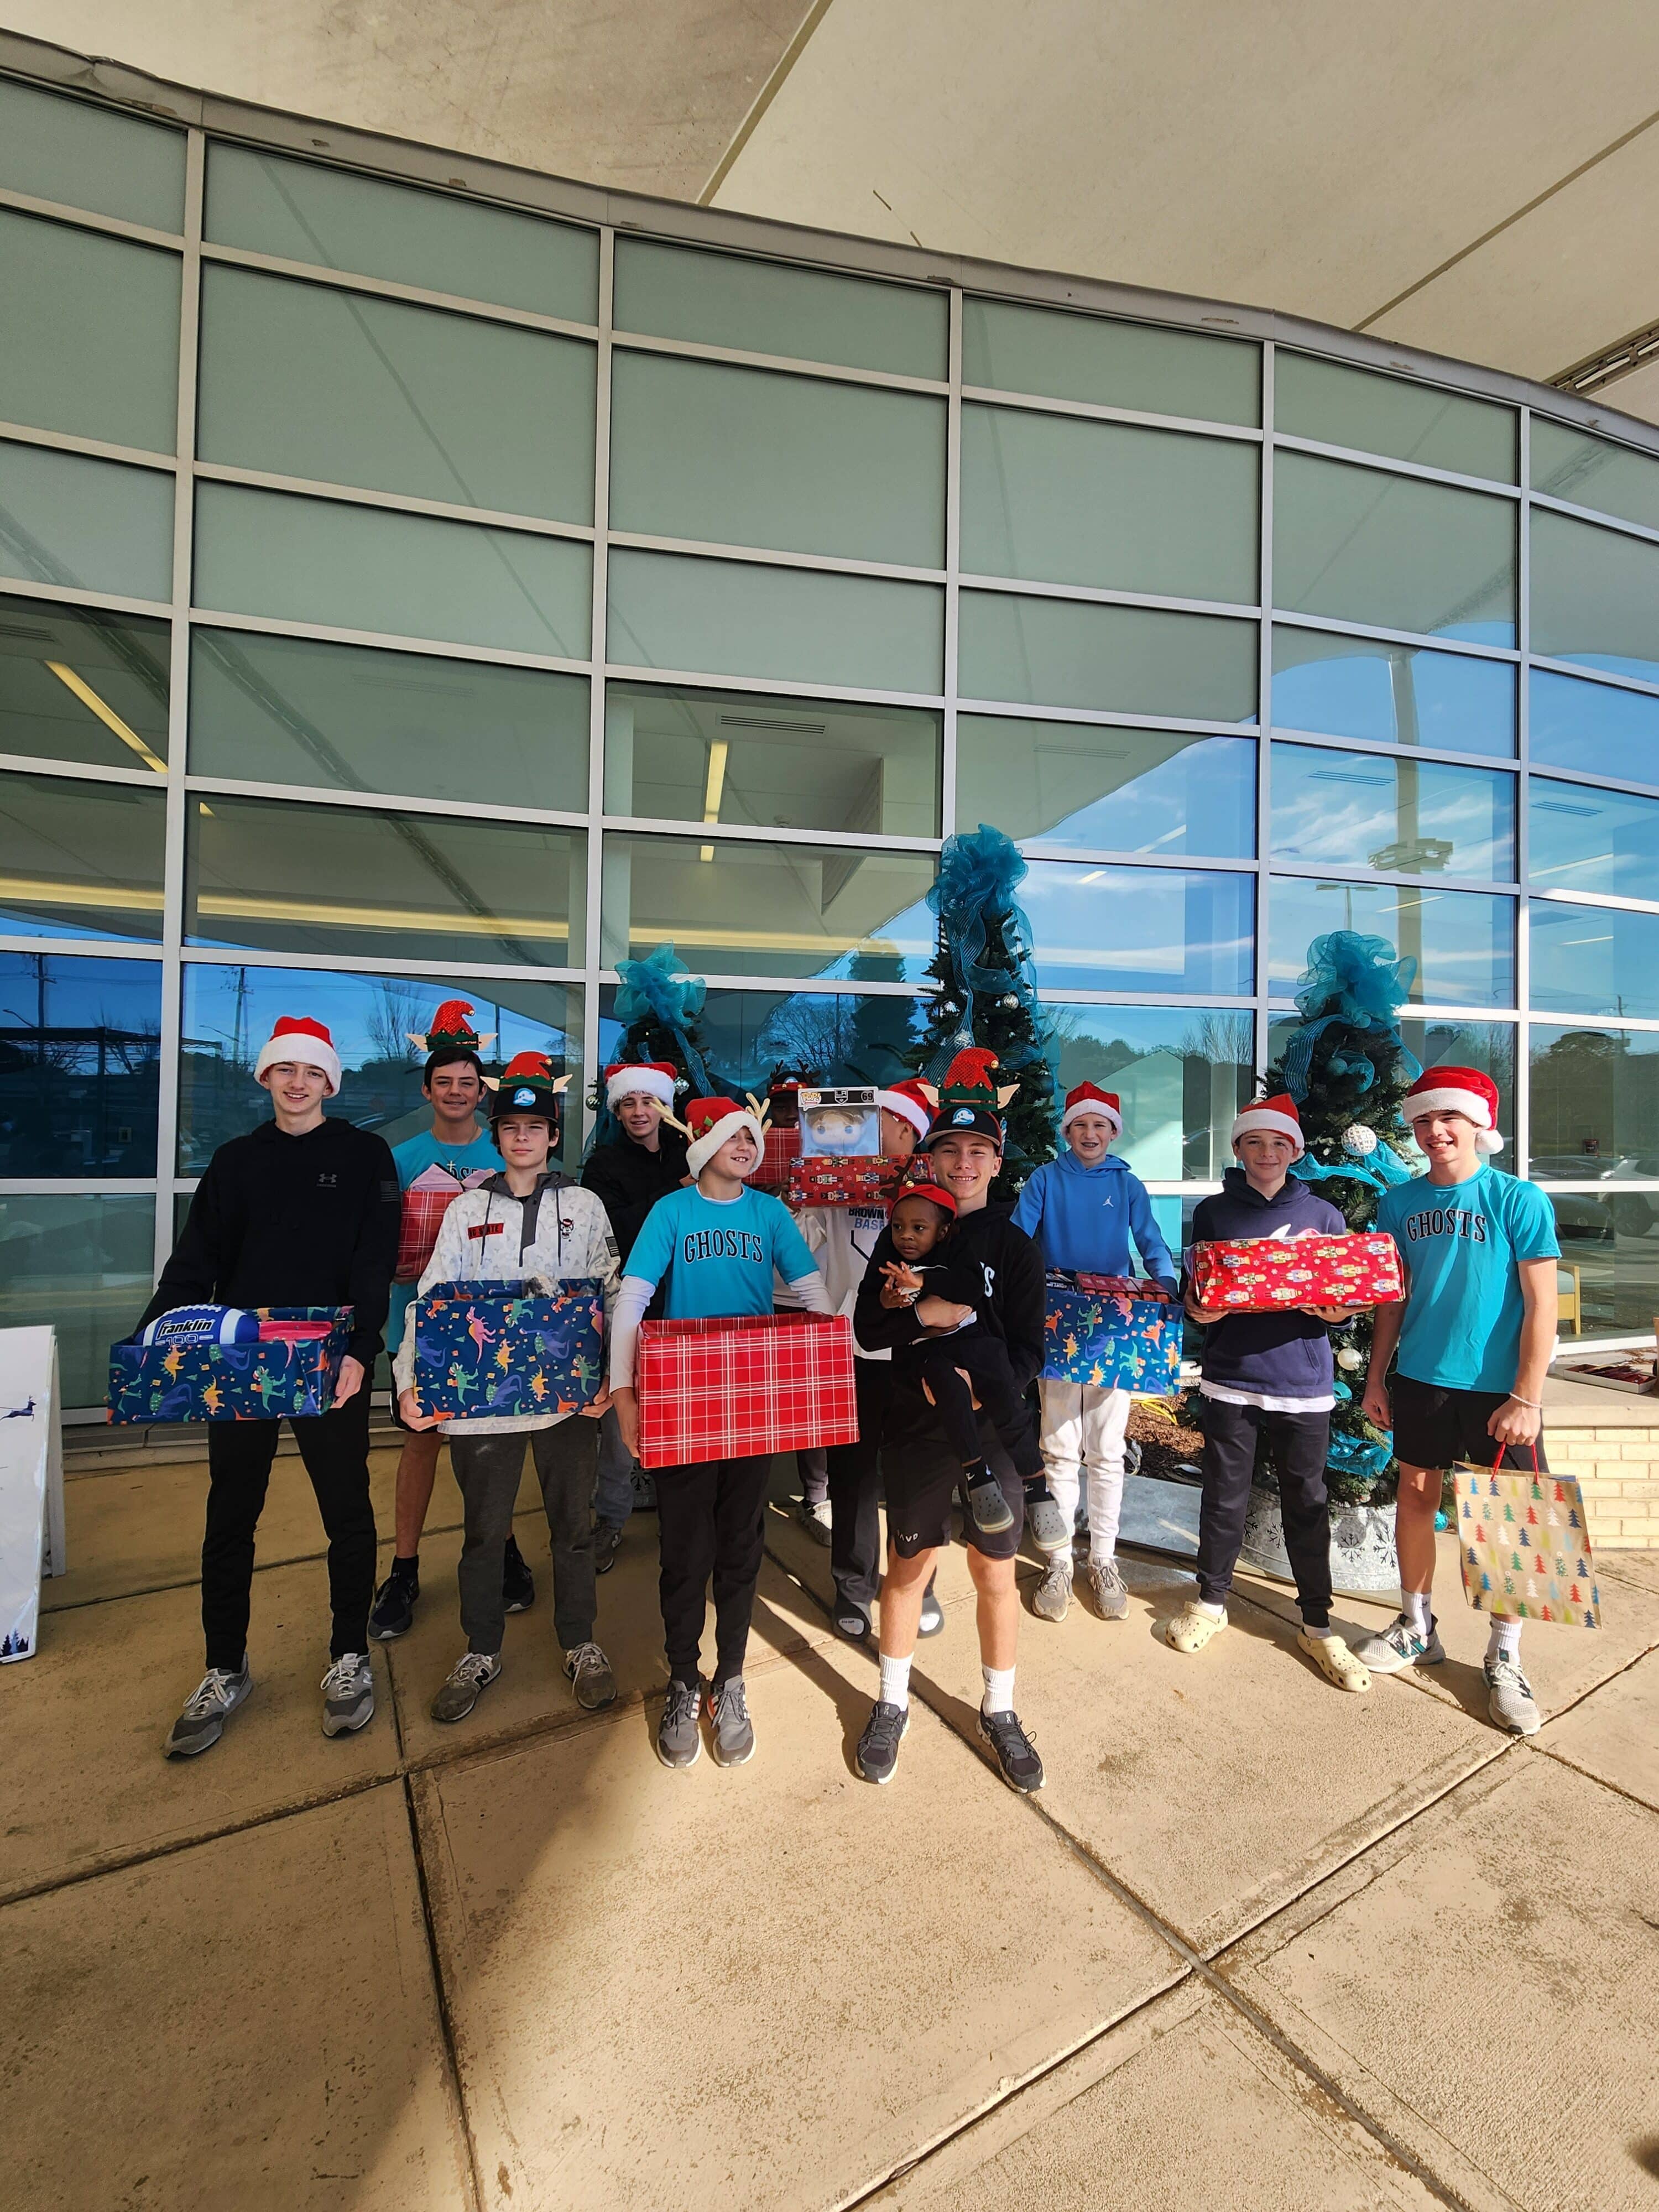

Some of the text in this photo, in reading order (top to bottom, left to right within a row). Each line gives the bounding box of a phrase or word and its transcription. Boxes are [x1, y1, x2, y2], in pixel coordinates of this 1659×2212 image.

[801, 1092, 821, 1102] POP!
[862, 1092, 874, 1100] 69
[1406, 1208, 1486, 1243] GHOSTS
[684, 1228, 764, 1264] GHOSTS
[155, 1319, 216, 1340] Franklin
